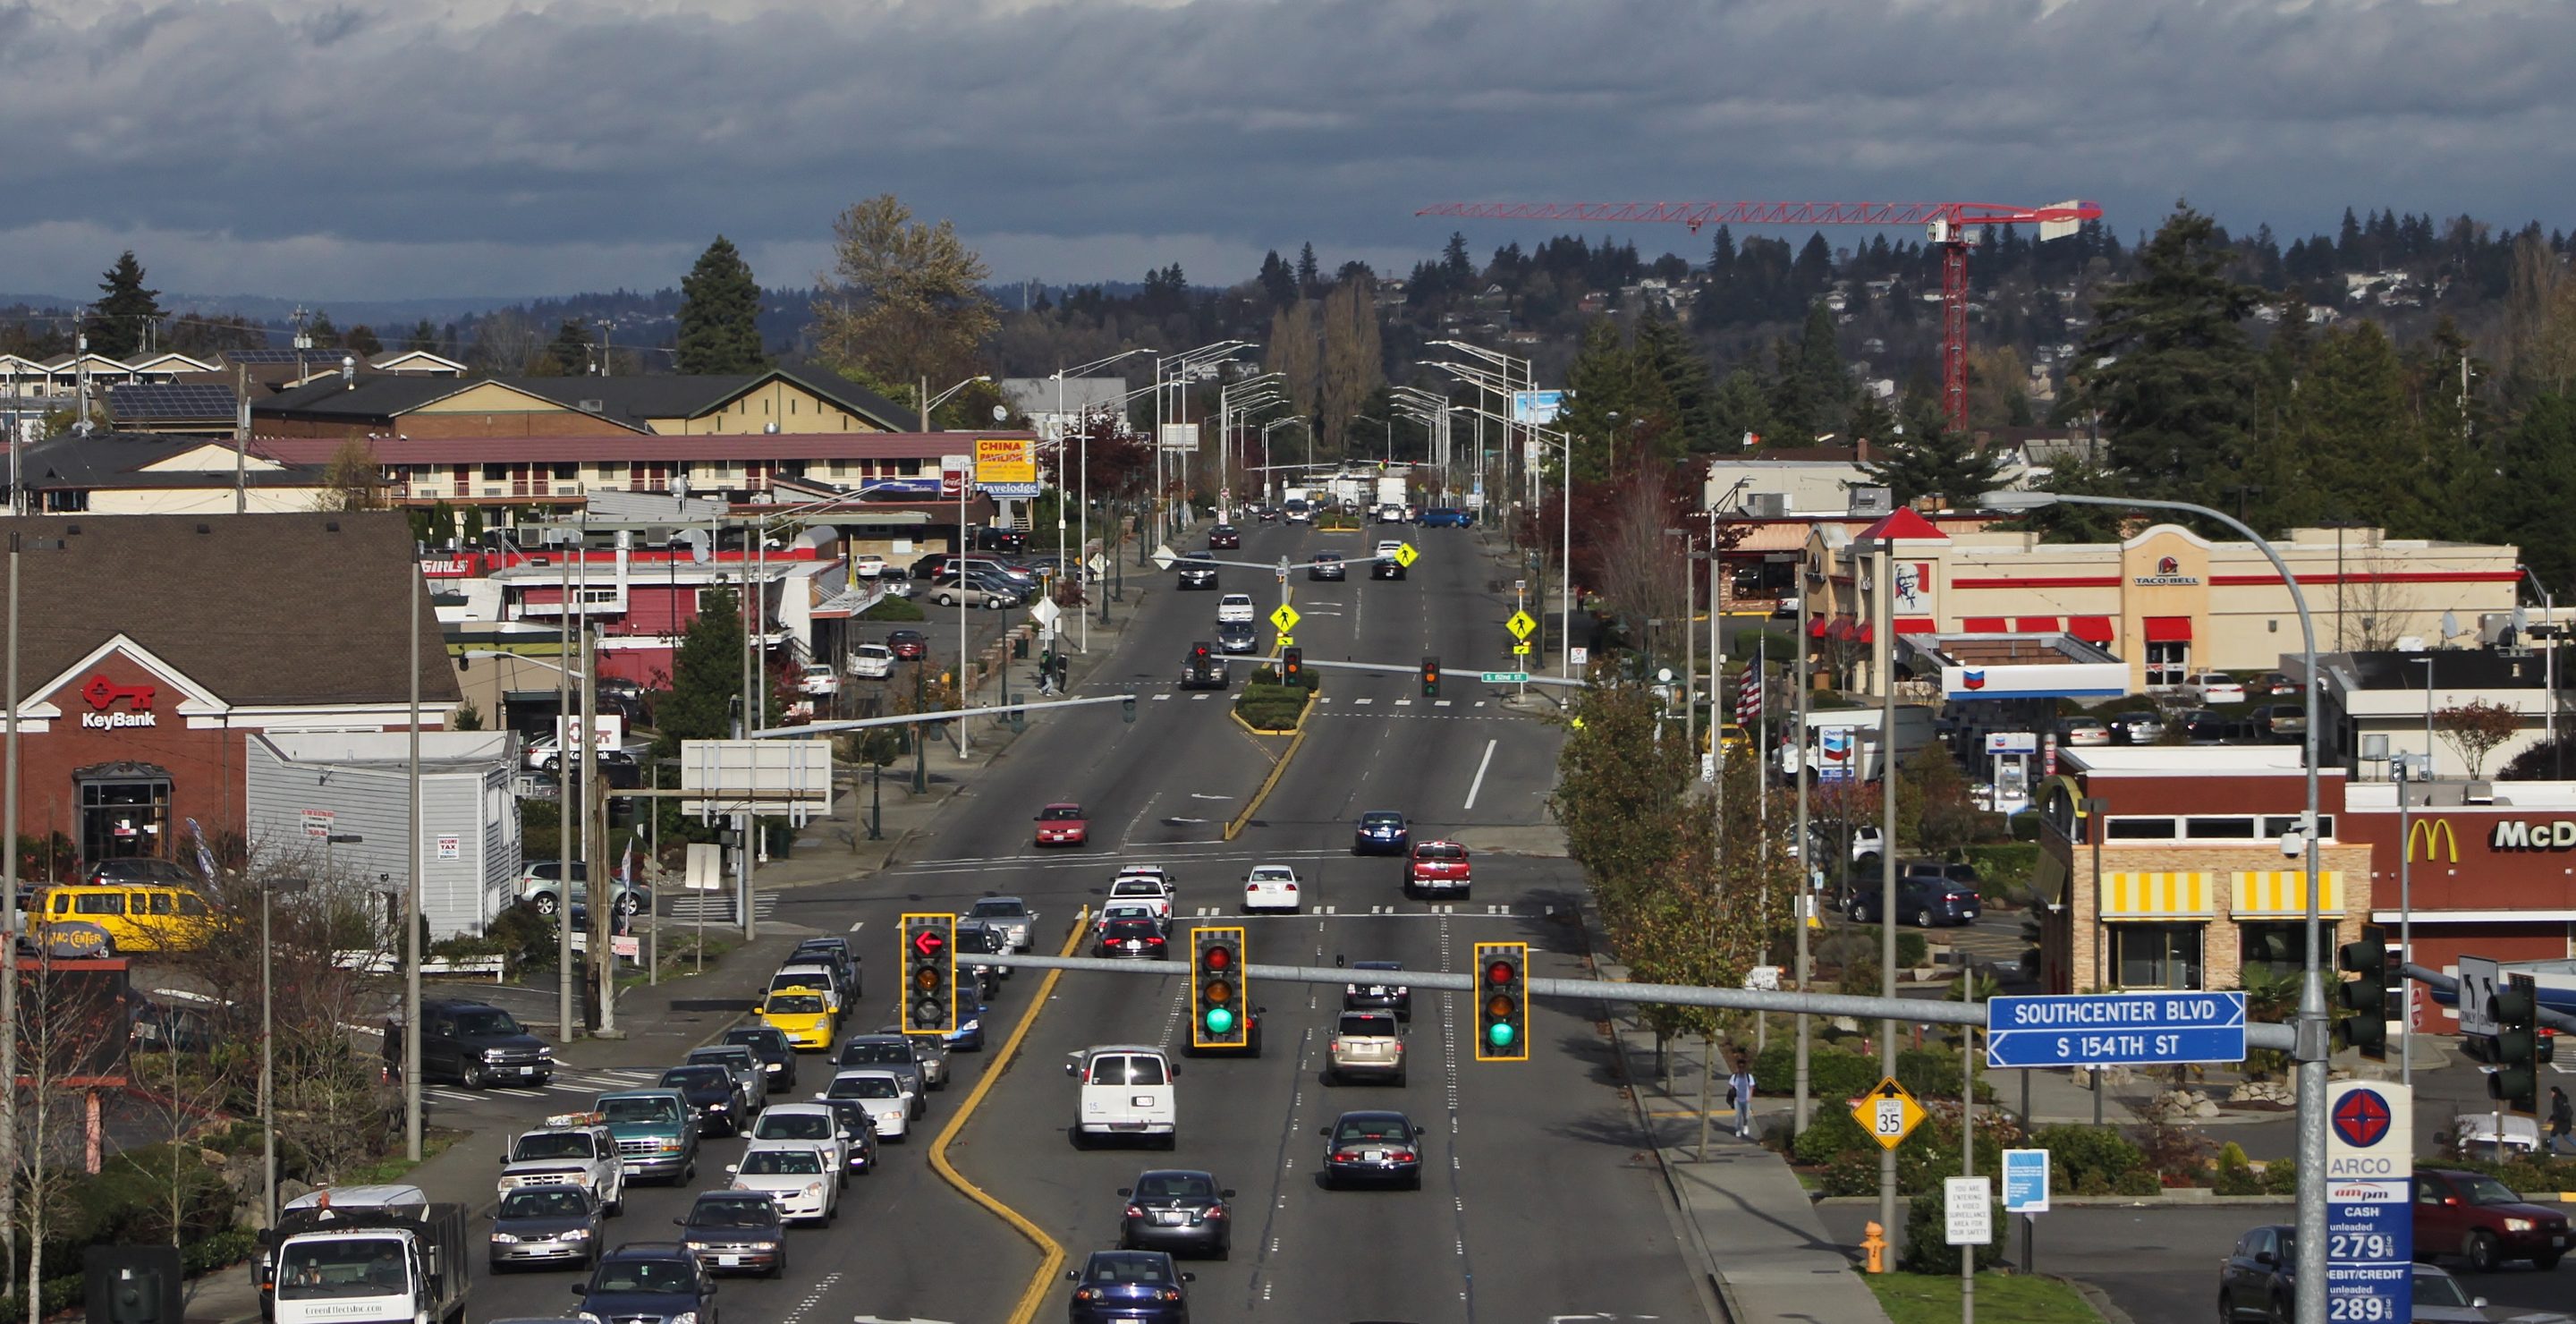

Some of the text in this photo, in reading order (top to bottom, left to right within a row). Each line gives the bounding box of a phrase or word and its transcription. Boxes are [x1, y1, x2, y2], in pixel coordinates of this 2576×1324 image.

[979, 442, 1021, 451] CHINA
[979, 454, 1023, 463] PAVILION
[974, 483, 1038, 494] Travelodge
[81, 711, 157, 731] KeyBank
[568, 751, 610, 760] Kenk
[70, 930, 103, 948] CENTER
[2014, 1000, 2216, 1025] SOUTHCENTER BLVD
[2460, 1010, 2477, 1023] ONLY
[2056, 1034, 2180, 1057] S 154TH ST
[1089, 1102, 1098, 1110] 15
[1878, 1114, 1900, 1133] 35
[2331, 1158, 2392, 1175] ARCO
[2334, 1190, 2388, 1201] ampm
[2343, 1207, 2380, 1218] CASH
[2329, 1223, 2373, 1232] unleaded
[2330, 1235, 2384, 1258] 279
[2329, 1286, 2373, 1294] unleaded
[2330, 1297, 2383, 1320] 289
